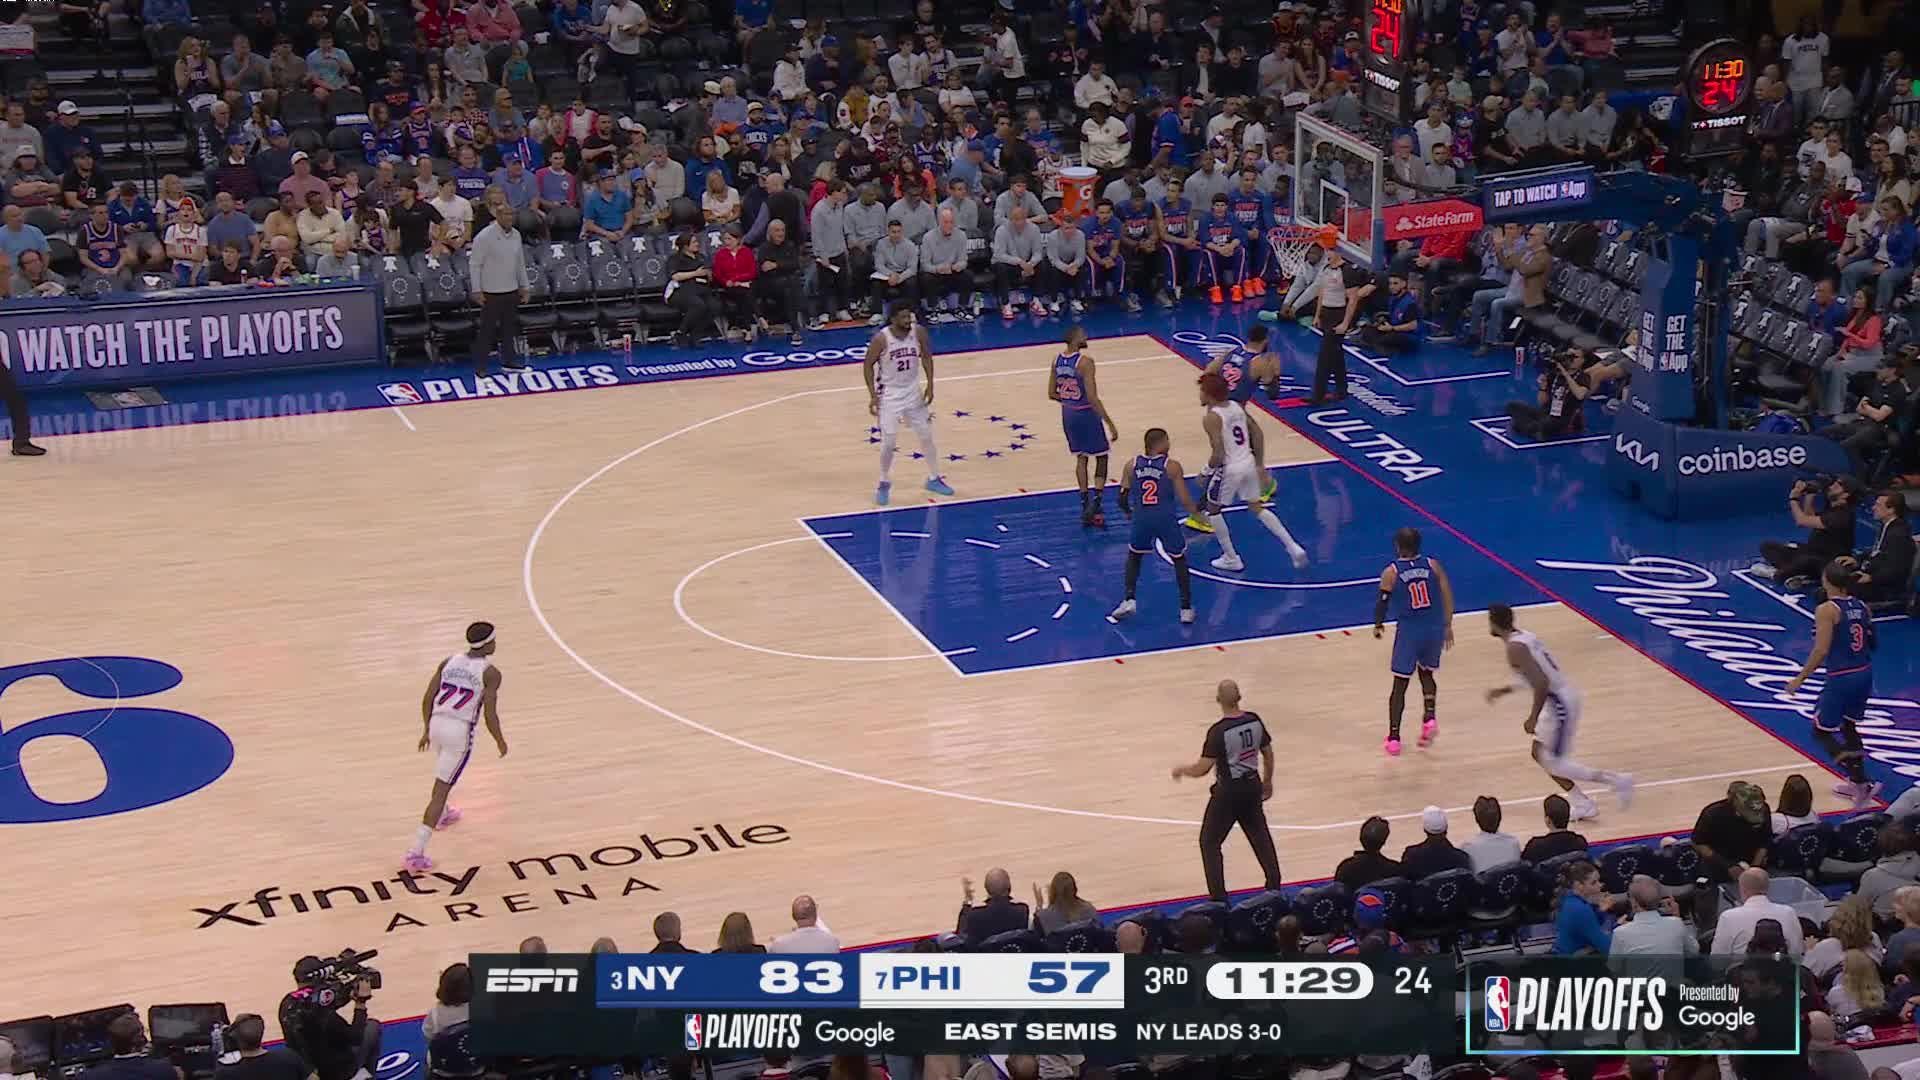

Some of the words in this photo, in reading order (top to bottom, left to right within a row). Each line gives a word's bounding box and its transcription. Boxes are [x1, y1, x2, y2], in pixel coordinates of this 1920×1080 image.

[1371, 8, 1400, 58] 24
[1704, 59, 1744, 80] 11:30
[1703, 79, 1736, 105] 24
[1708, 115, 1746, 128] TISSOT
[1495, 190, 1511, 207] TAP
[1513, 188, 1525, 204] TO
[1526, 184, 1557, 202] WATCH
[1569, 181, 1586, 198] App
[1667, 315, 1687, 332] GET
[18, 322, 128, 373] WATCH
[134, 317, 195, 365] THE
[201, 307, 342, 359] PLAYOFFS
[1666, 333, 1685, 350] THE
[423, 364, 619, 400] PLAYOFFS
[628, 359, 713, 377] Presented
[713, 357, 737, 371] by
[742, 342, 868, 366] Goog
[898, 359, 910, 372] 21
[1669, 352, 1688, 373] App
[1233, 426, 1245, 446] 9
[1306, 409, 1444, 483] ULTRA
[1678, 444, 1807, 475] coinbase
[1142, 480, 1158, 504] 2
[1408, 580, 1432, 609] 11
[1850, 623, 1864, 652] 3
[438, 681, 475, 709] 77
[1239, 728, 1254, 749] 10
[191, 866, 480, 929] xfinity
[507, 822, 791, 880] mobile
[385, 876, 662, 932] ARENA
